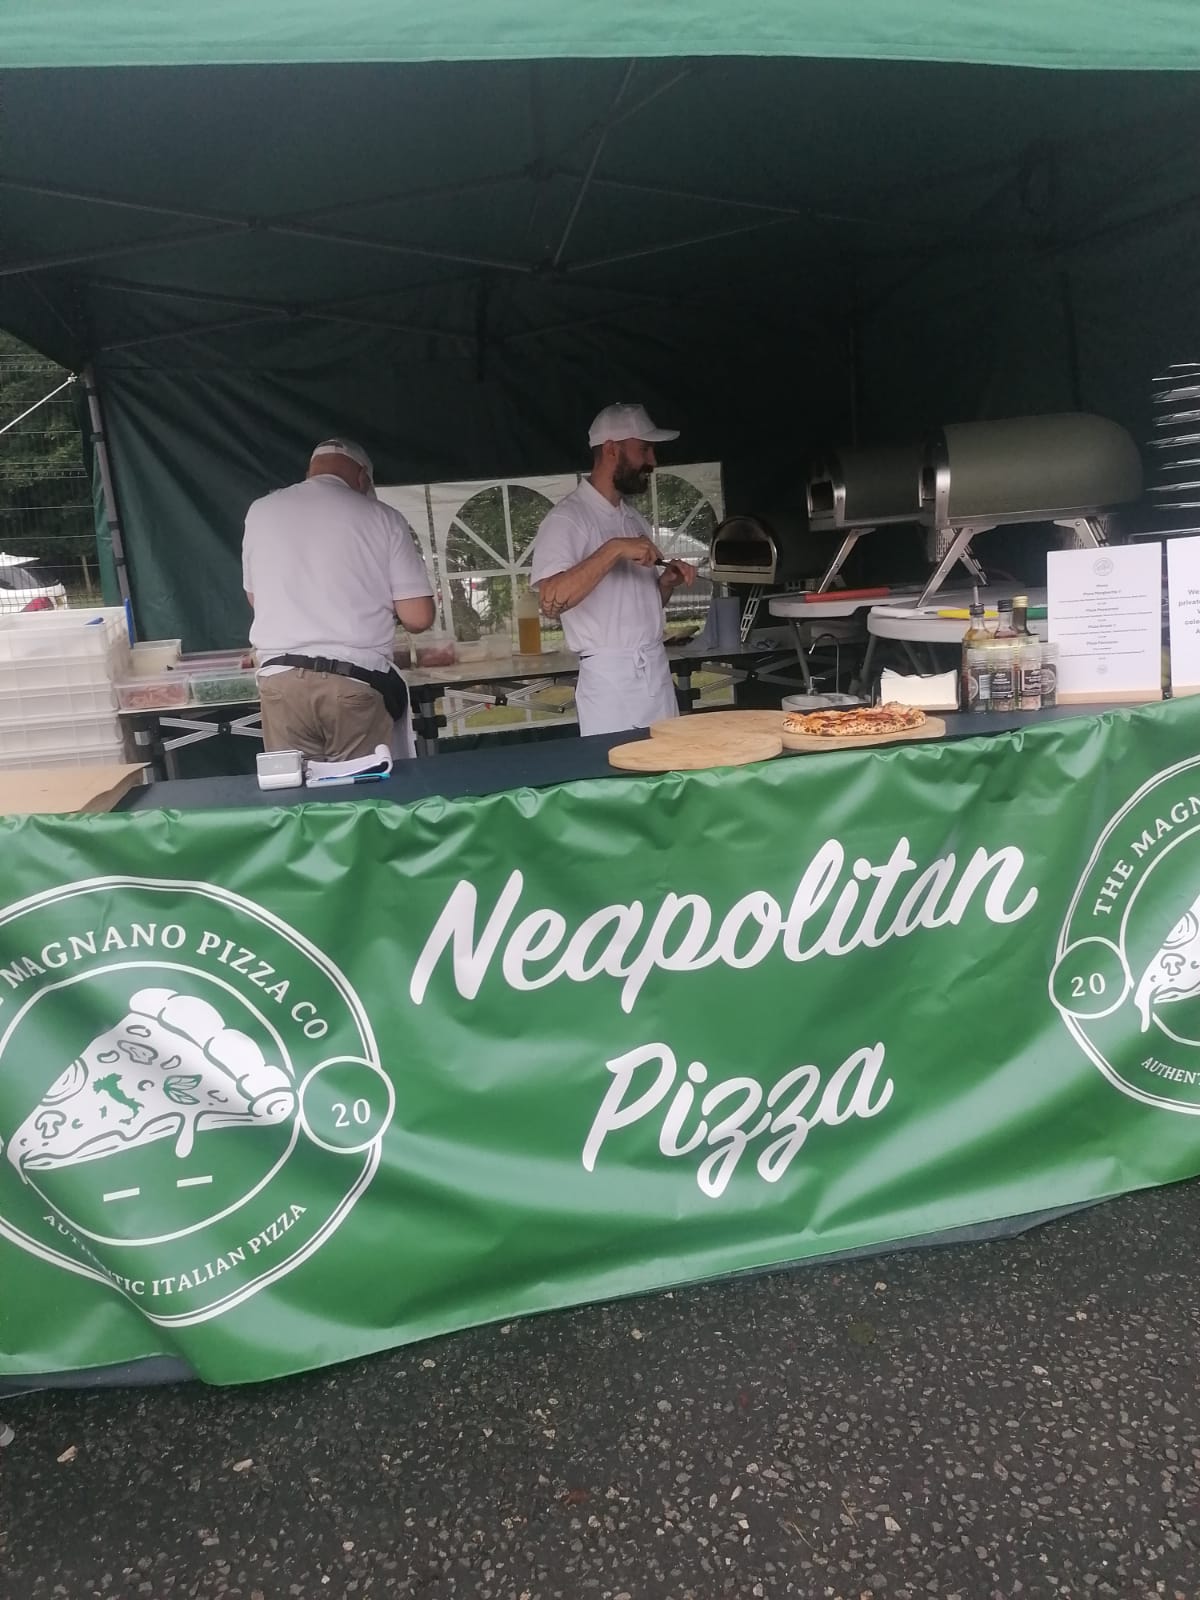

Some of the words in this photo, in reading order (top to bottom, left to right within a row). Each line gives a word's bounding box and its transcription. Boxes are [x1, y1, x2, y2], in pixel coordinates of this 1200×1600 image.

[410, 836, 1039, 1014] Neapolitan
[1092, 859, 1134, 917] THE
[0, 923, 187, 989] MAGNANO
[196, 929, 290, 1004] PIZZA
[290, 1000, 329, 1039] CO
[1070, 972, 1107, 998] 20
[331, 1098, 371, 1128] 20
[582, 1041, 894, 1199] Pizza
[151, 1246, 246, 1296] ITALIAN
[248, 1203, 308, 1255] PIZZA
